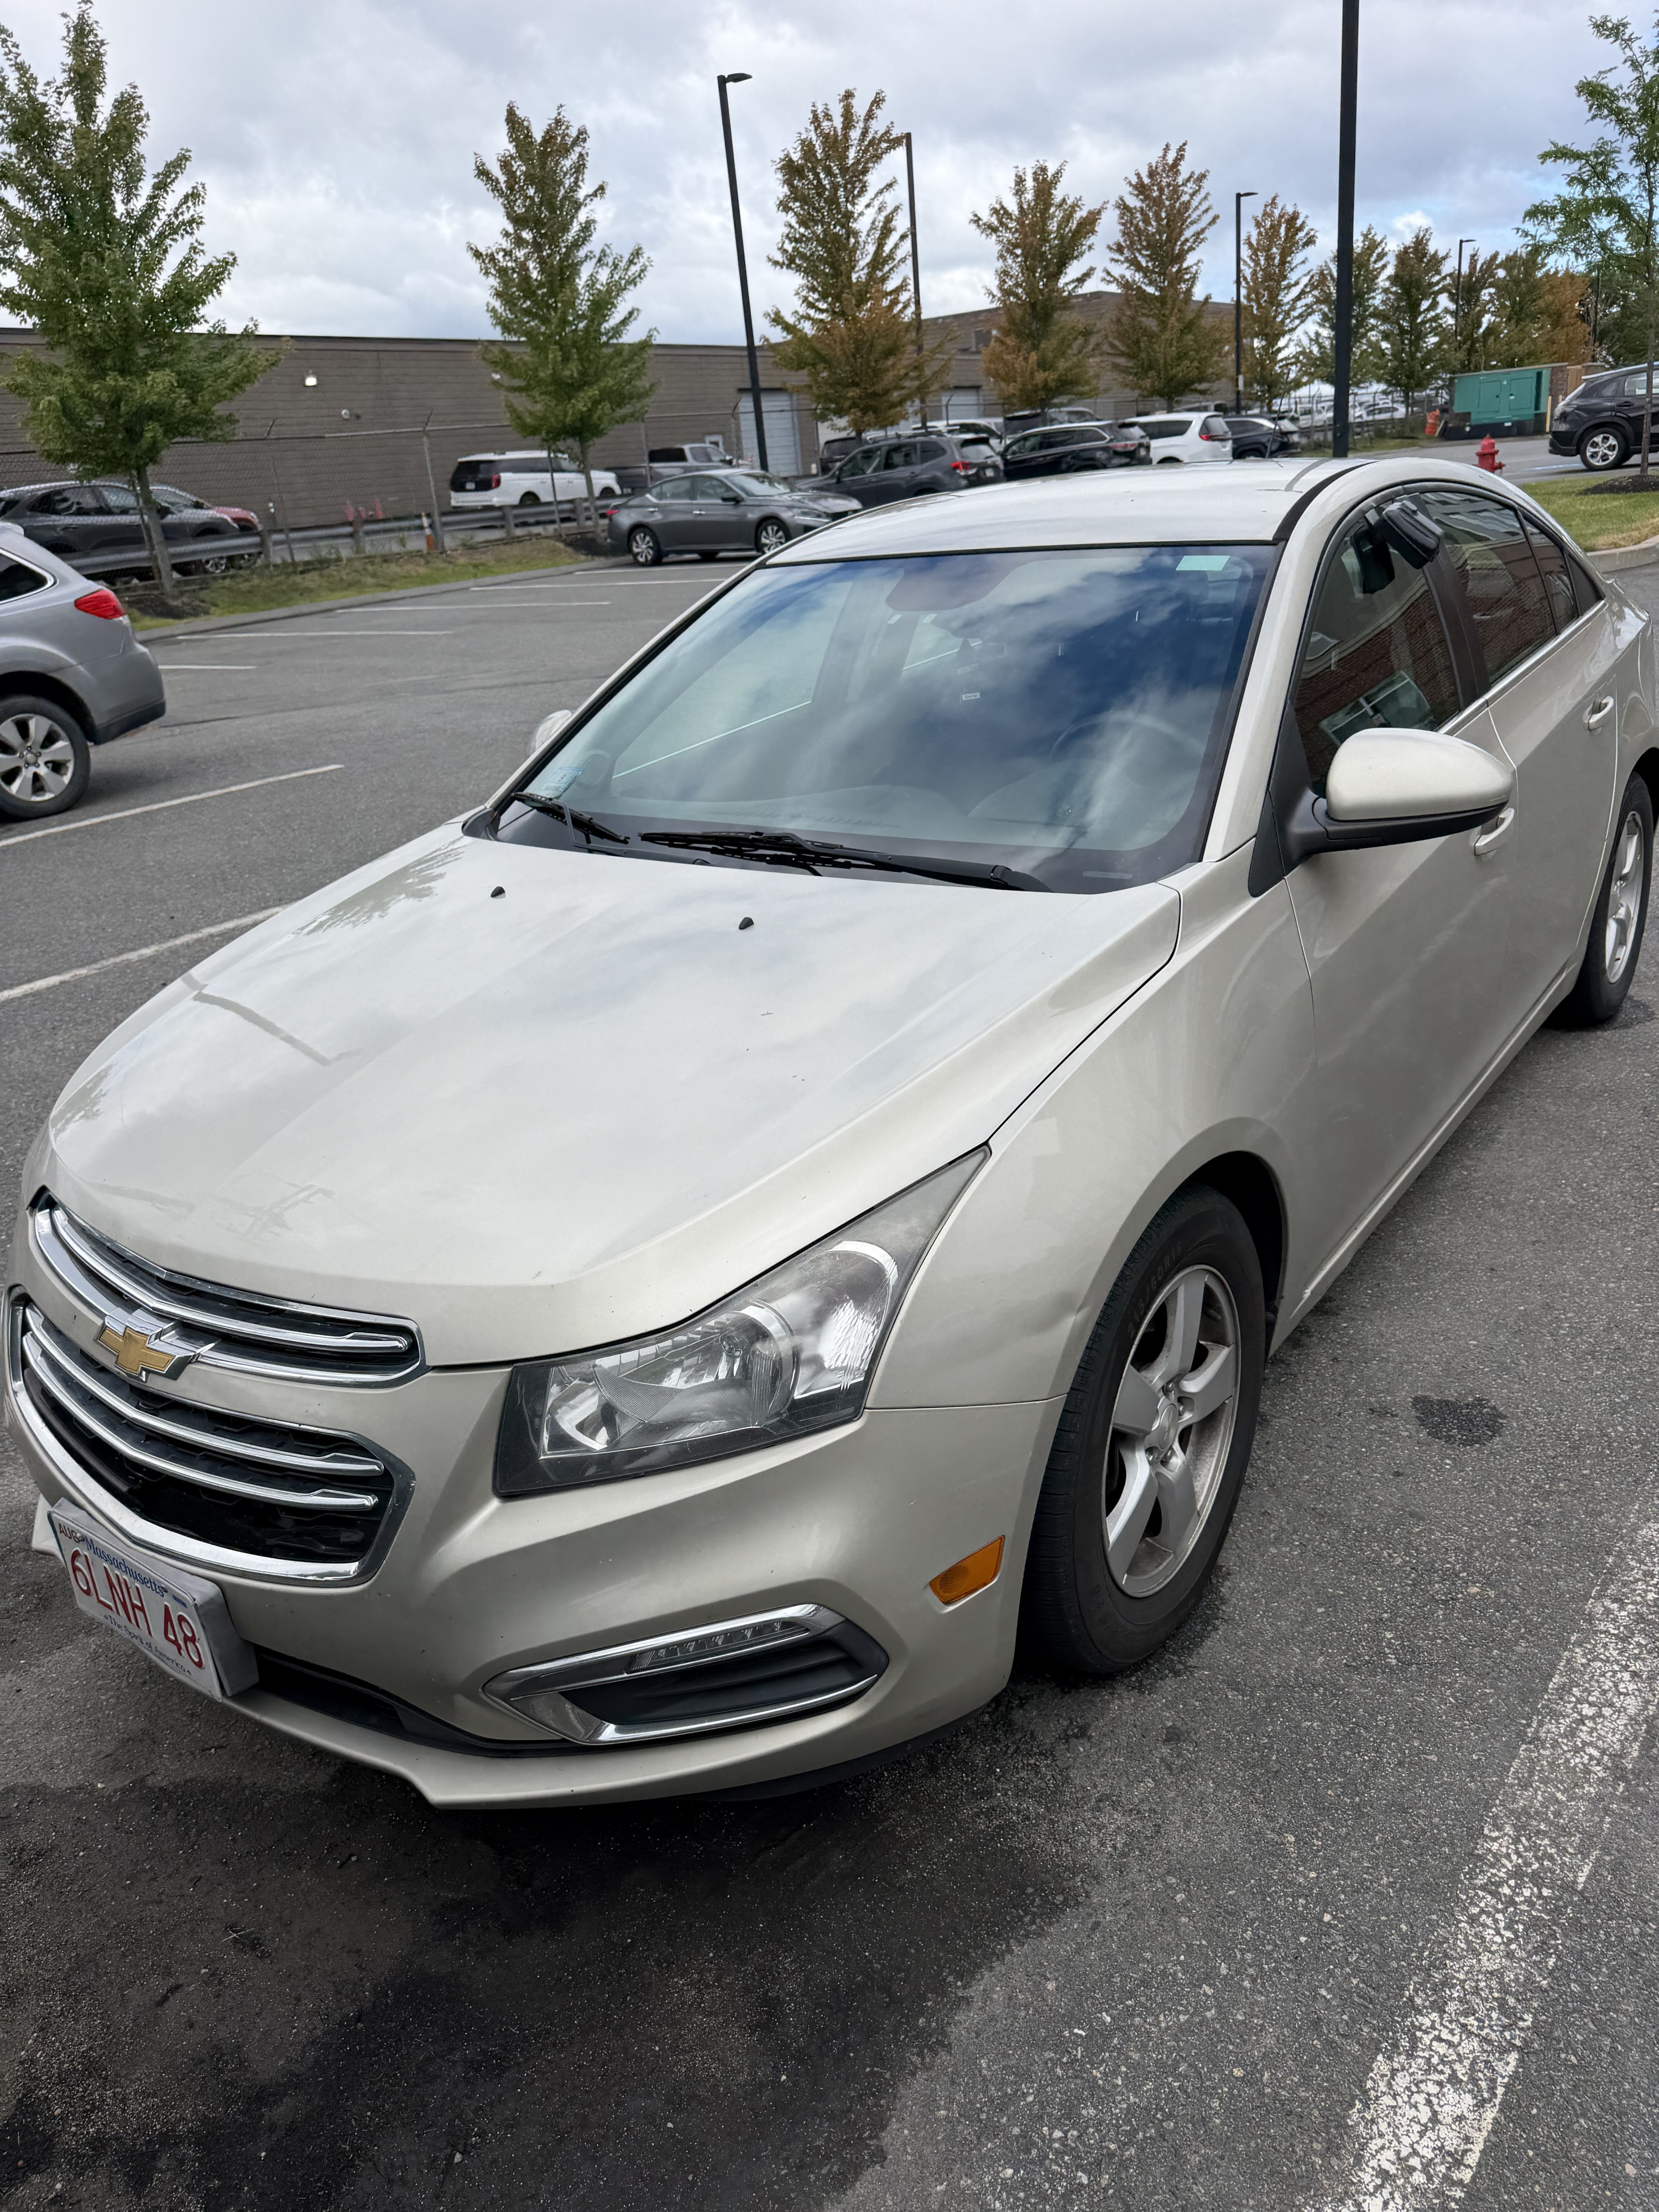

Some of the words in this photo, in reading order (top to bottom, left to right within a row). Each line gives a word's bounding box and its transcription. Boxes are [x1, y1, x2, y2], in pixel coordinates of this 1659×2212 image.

[71, 1548, 153, 1637] 6LNH
[164, 1602, 204, 1668] 48
[85, 1536, 165, 1597] Massachusetts
